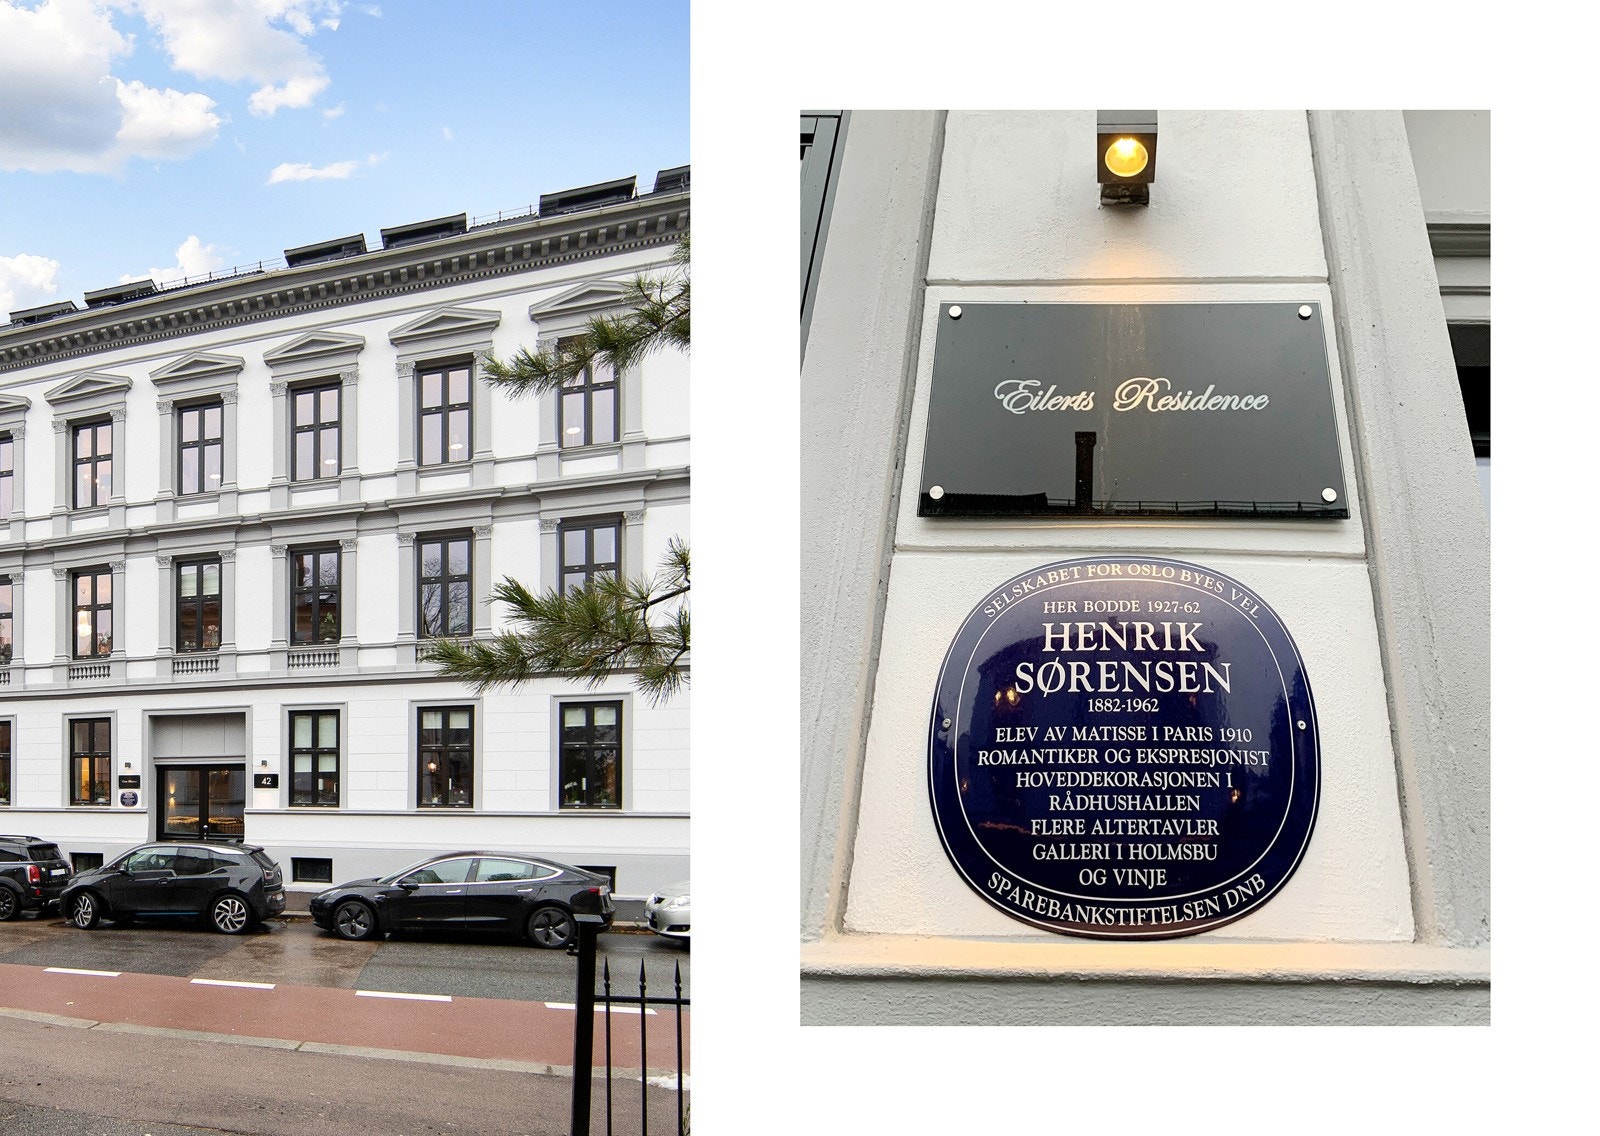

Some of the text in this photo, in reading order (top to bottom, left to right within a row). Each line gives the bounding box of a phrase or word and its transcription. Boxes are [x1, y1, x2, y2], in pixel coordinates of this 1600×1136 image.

[994, 377, 1269, 414] Eilerts Residence
[984, 563, 1260, 620] SELSKABET FOR OSLO BYES VEL
[1043, 600, 1201, 614] HER BODDE 1927-62
[1042, 621, 1205, 652] HENRIK
[1014, 657, 1232, 697] SØRENSEN
[1087, 699, 1159, 713] 1882-1962
[995, 726, 1252, 743] ELEV AV MATISSE I PARIS 1910
[977, 749, 1270, 768] ROMANTIKER OG EKSPRESJONIST
[261, 776, 272, 785] 42
[1015, 771, 1233, 789] HOVEDDEKORASJONEN I
[1049, 791, 1201, 811] RÅDHUSHALLEN
[1030, 819, 1220, 836] FLERE ALTERTAVLER
[1032, 844, 1218, 861] GALLERI I HOLMSBU
[1079, 868, 1168, 889] OG VINJE
[987, 872, 1267, 926] SPAREBANKSTIFTELSEN DNB
